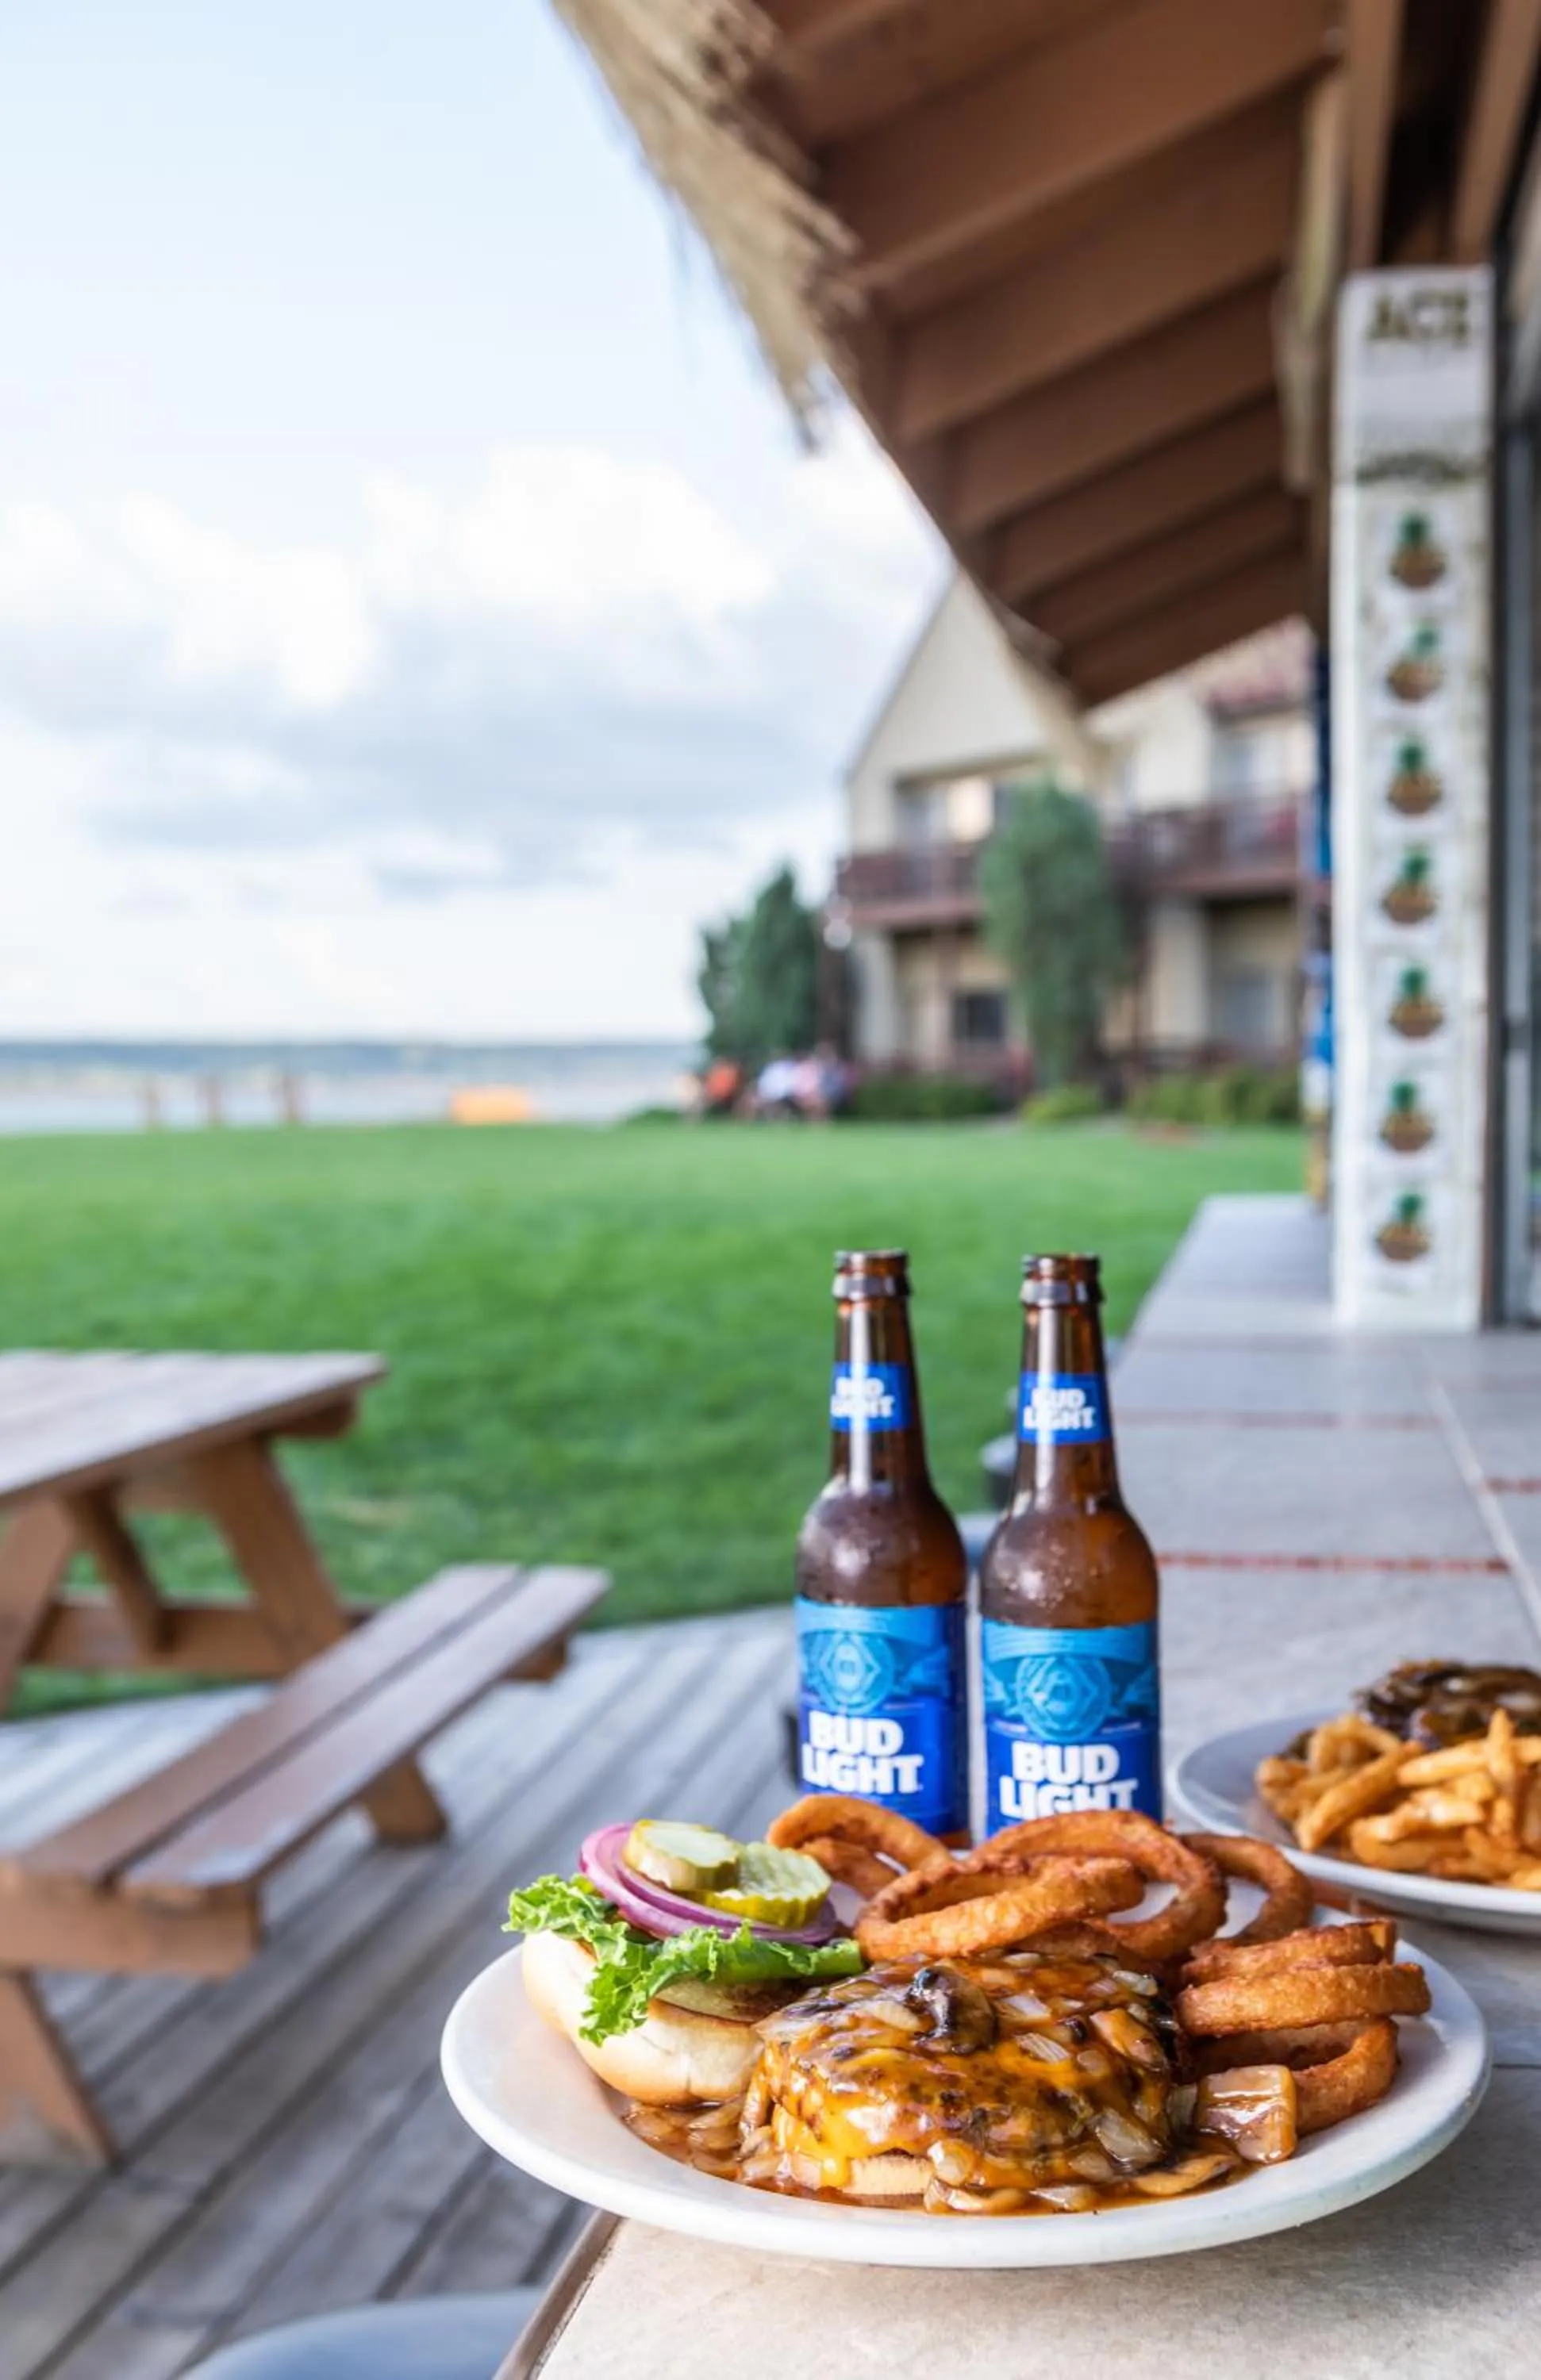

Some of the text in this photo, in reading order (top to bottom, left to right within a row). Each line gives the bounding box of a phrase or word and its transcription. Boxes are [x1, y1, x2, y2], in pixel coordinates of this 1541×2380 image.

[809, 1710, 904, 1758] BUD
[801, 1743, 925, 1795] LIGHT
[1012, 1741, 1120, 1786] BUD
[999, 1775, 1139, 1821] LIGHT
